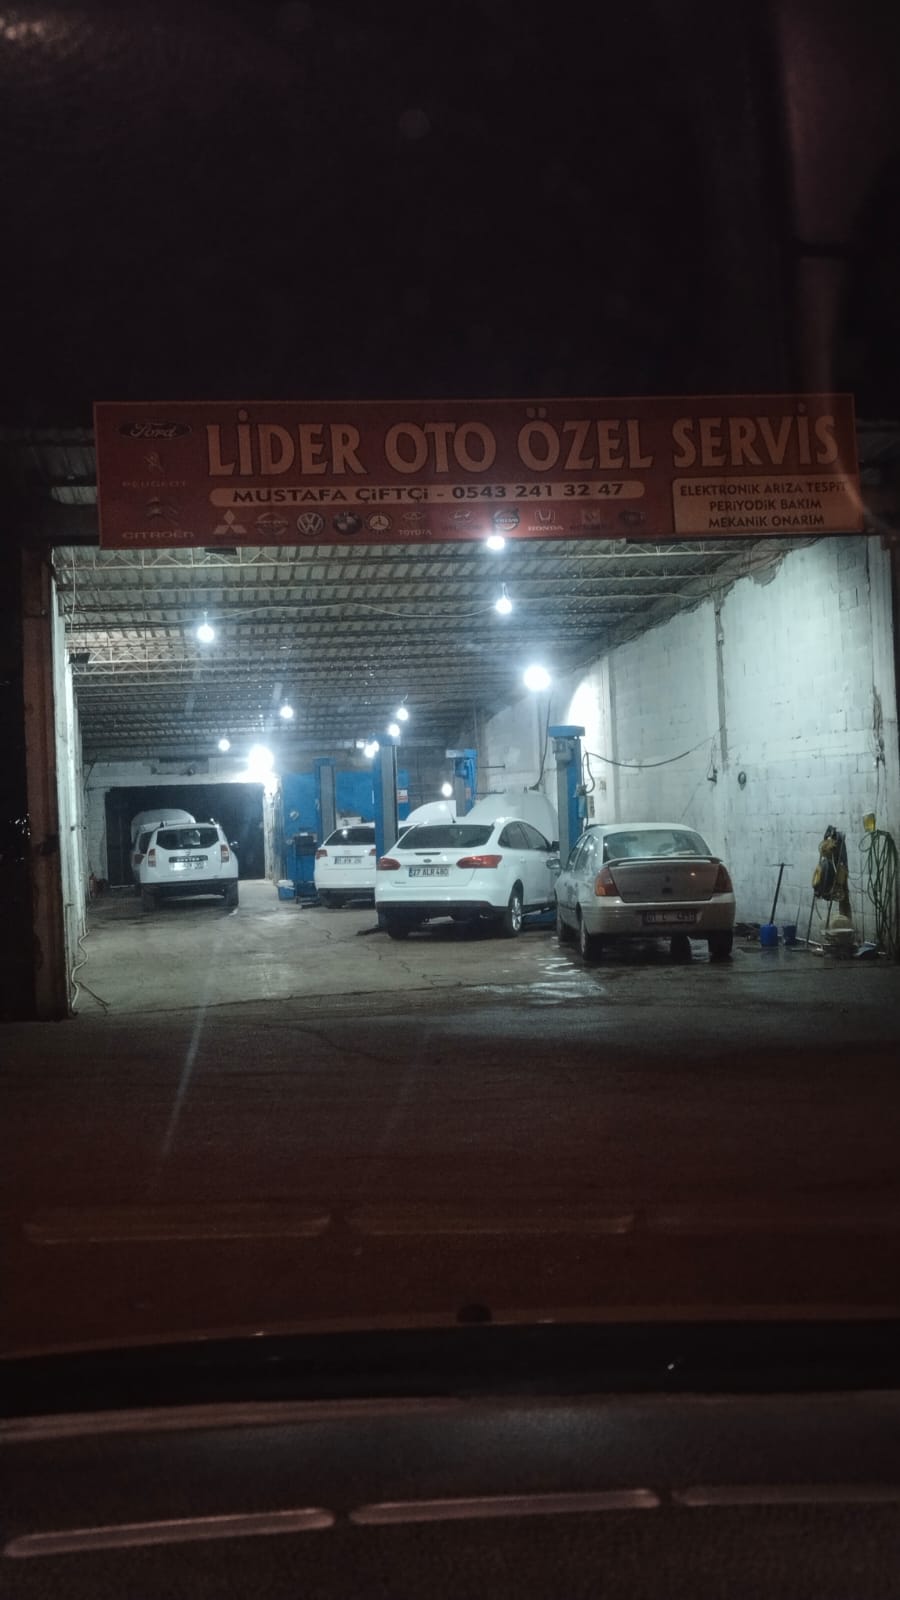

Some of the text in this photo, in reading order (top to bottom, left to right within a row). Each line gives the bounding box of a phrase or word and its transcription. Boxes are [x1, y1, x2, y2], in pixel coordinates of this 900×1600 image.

[206, 402, 839, 476] LİDER OTO ÖZEL SERVİS
[232, 488, 347, 502] MUSTAFA
[452, 486, 507, 499] 0543
[515, 485, 552, 498] 241
[563, 484, 591, 496] 32
[598, 483, 624, 496] 47
[764, 482, 803, 495] ARIZA
[781, 498, 823, 510] BAKIM
[771, 514, 825, 526] ONARIM
